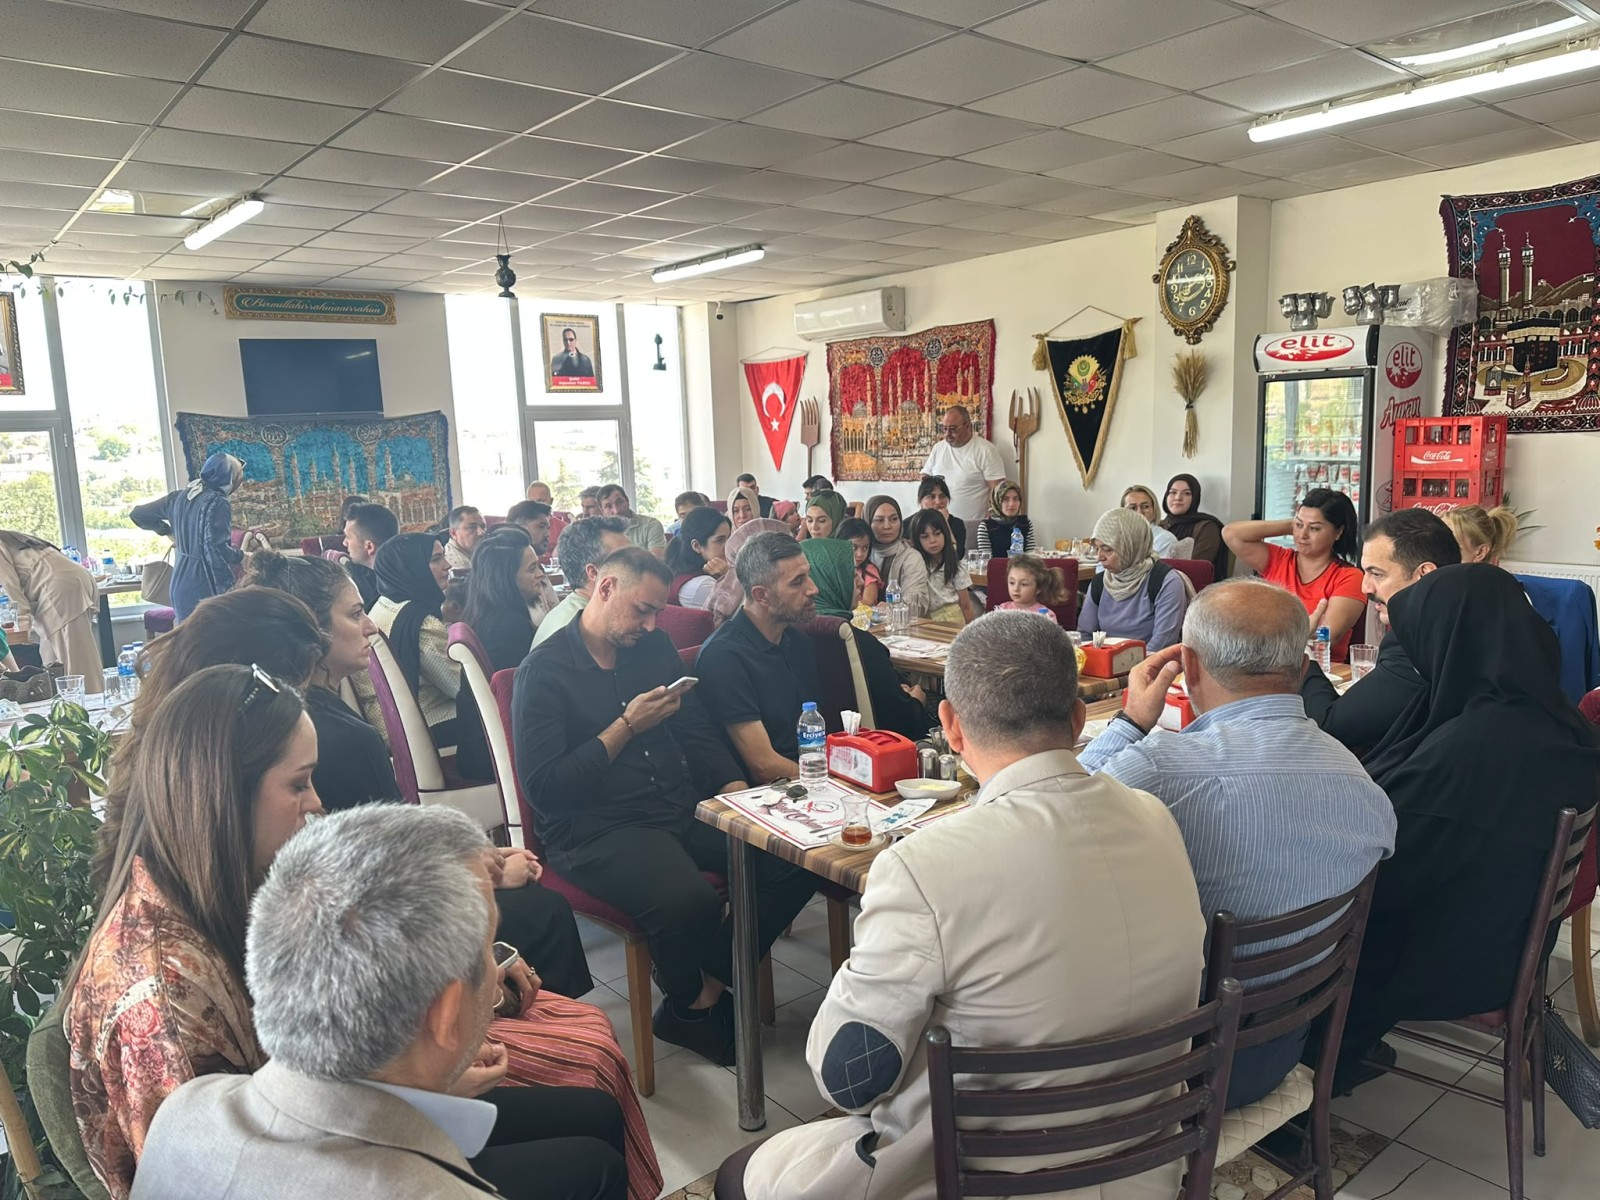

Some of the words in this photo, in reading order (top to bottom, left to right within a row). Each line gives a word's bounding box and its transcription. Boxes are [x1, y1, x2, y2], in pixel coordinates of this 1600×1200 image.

[1187, 255, 1197, 265] 12
[1177, 264, 1184, 273] 11
[1171, 284, 1178, 293] 9
[1204, 288, 1211, 297] 4
[1173, 294, 1180, 303] 8
[1200, 299, 1206, 309] 5
[1189, 306, 1196, 316] 6
[1281, 335, 1335, 349] elit
[1393, 345, 1415, 367] elit
